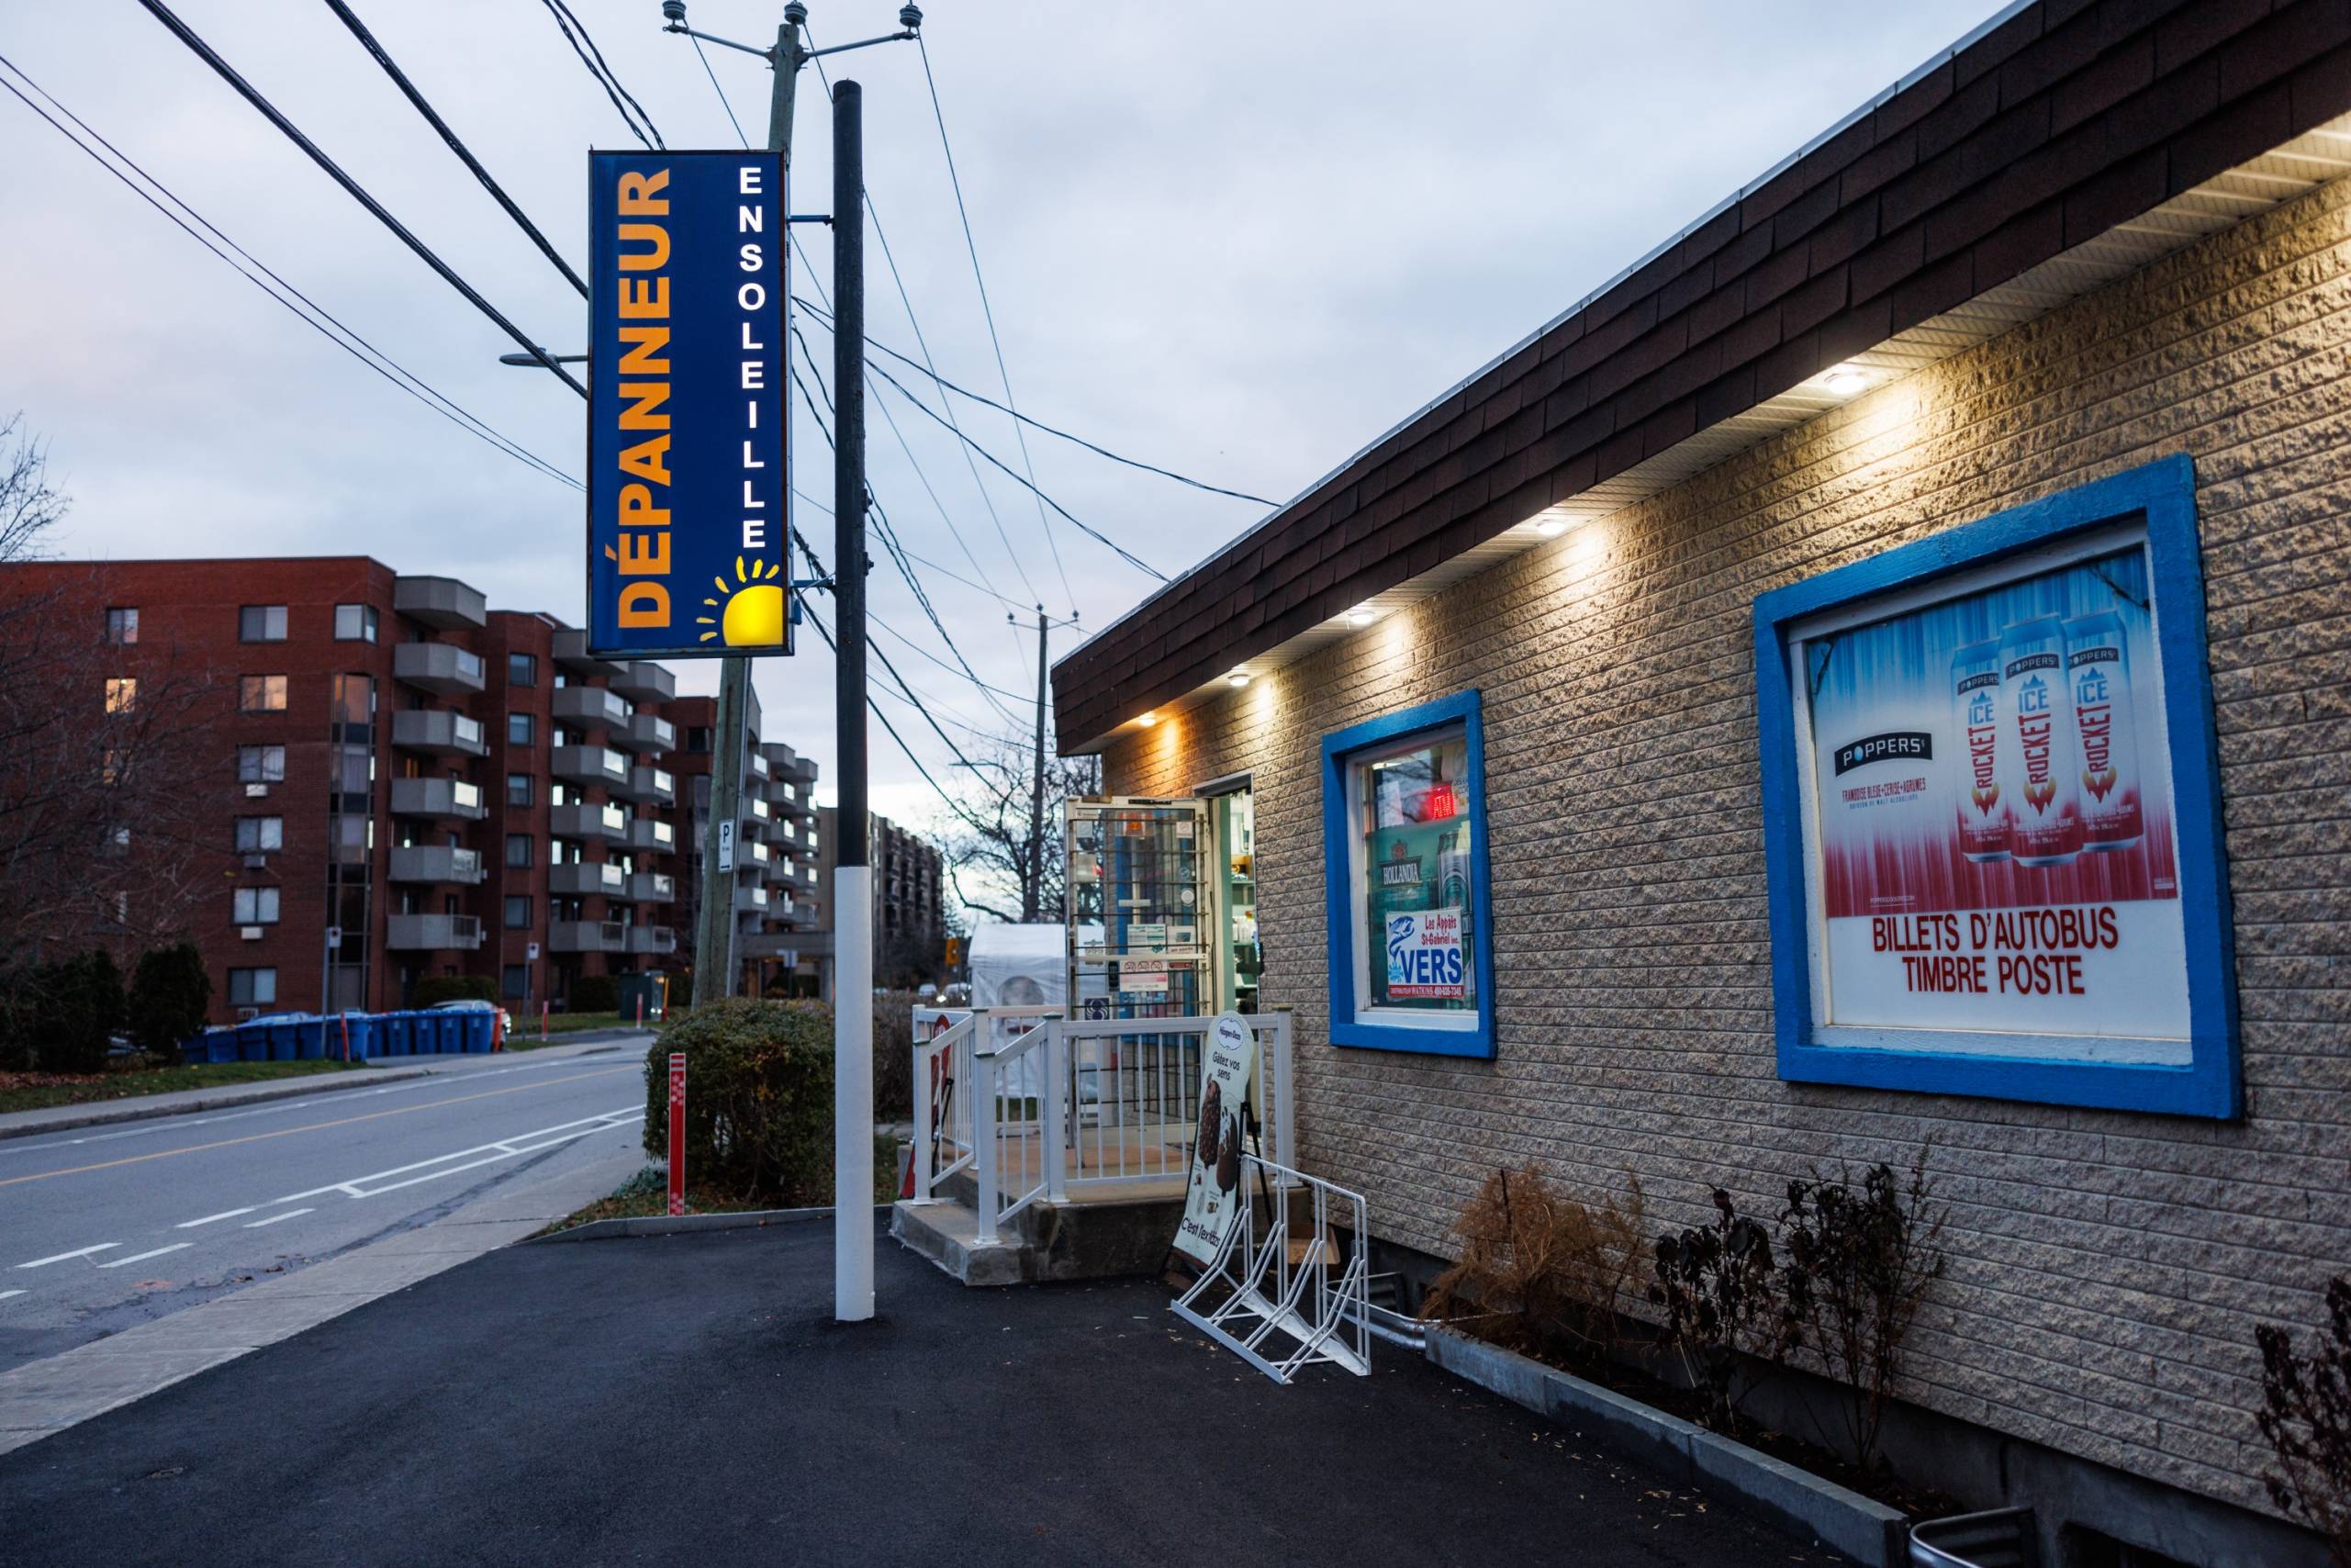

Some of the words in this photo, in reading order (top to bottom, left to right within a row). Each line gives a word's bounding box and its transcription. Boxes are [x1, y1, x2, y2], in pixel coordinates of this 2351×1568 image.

[738, 167, 766, 548] ENSOLEILLE
[605, 168, 671, 628] DÉPANNEUR
[2009, 656, 2055, 676] POPPERS
[1960, 674, 1998, 691] POPPERS
[2077, 679, 2110, 705] ICE
[2018, 687, 2050, 713] ICE
[1968, 703, 1995, 725] ICE
[2018, 713, 2051, 785] ROCKET
[2077, 704, 2110, 773] ROCKET
[1842, 737, 1921, 767] POPPERS
[1968, 725, 1996, 789] ROCKET
[723, 824, 730, 844] P
[1383, 862, 1419, 885] HOLLANDIA
[1425, 914, 1435, 930] Les
[1872, 913, 1961, 952] BILLETS
[1969, 906, 2119, 951] D'AUTOBUS
[1400, 947, 1462, 985] VERS
[1902, 955, 1988, 993] TIMBRE
[1998, 954, 2085, 995] POSTE
[1217, 1068, 1231, 1081] sens
[1230, 1059, 1240, 1071] vos
